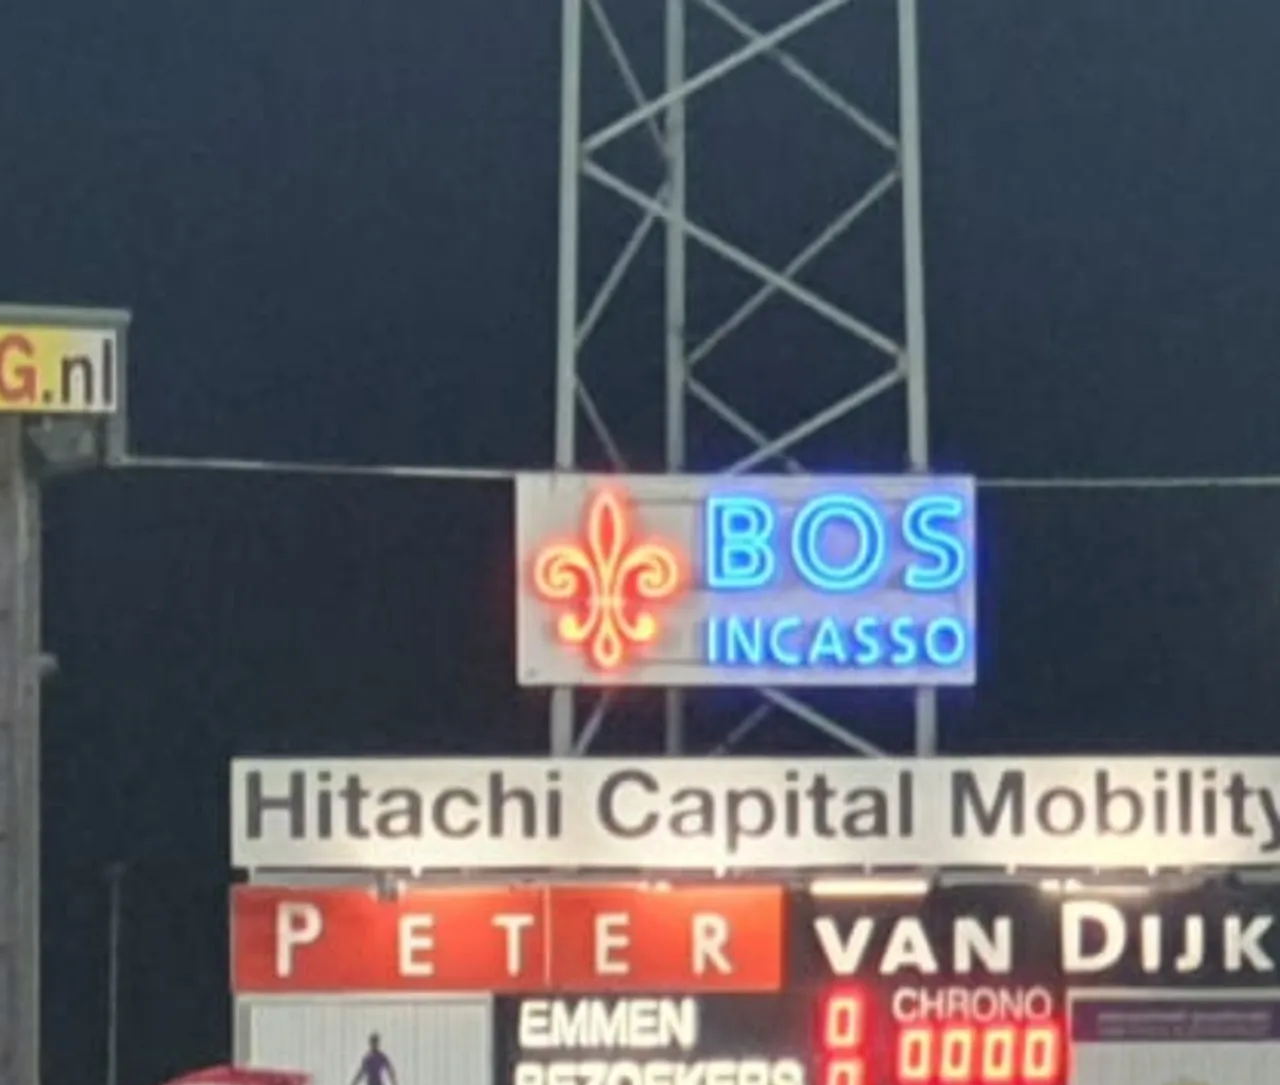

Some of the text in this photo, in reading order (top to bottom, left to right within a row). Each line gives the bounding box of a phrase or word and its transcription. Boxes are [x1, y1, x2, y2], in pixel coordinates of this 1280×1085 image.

[707, 493, 965, 590] BOS
[708, 616, 965, 665] INCASSO
[244, 768, 1280, 853] Hitachi Capital Mobility
[275, 898, 1275, 978] PETER VAN DIJK
[519, 997, 696, 1049] EMMEN
[892, 987, 1053, 1023] CHRONO
